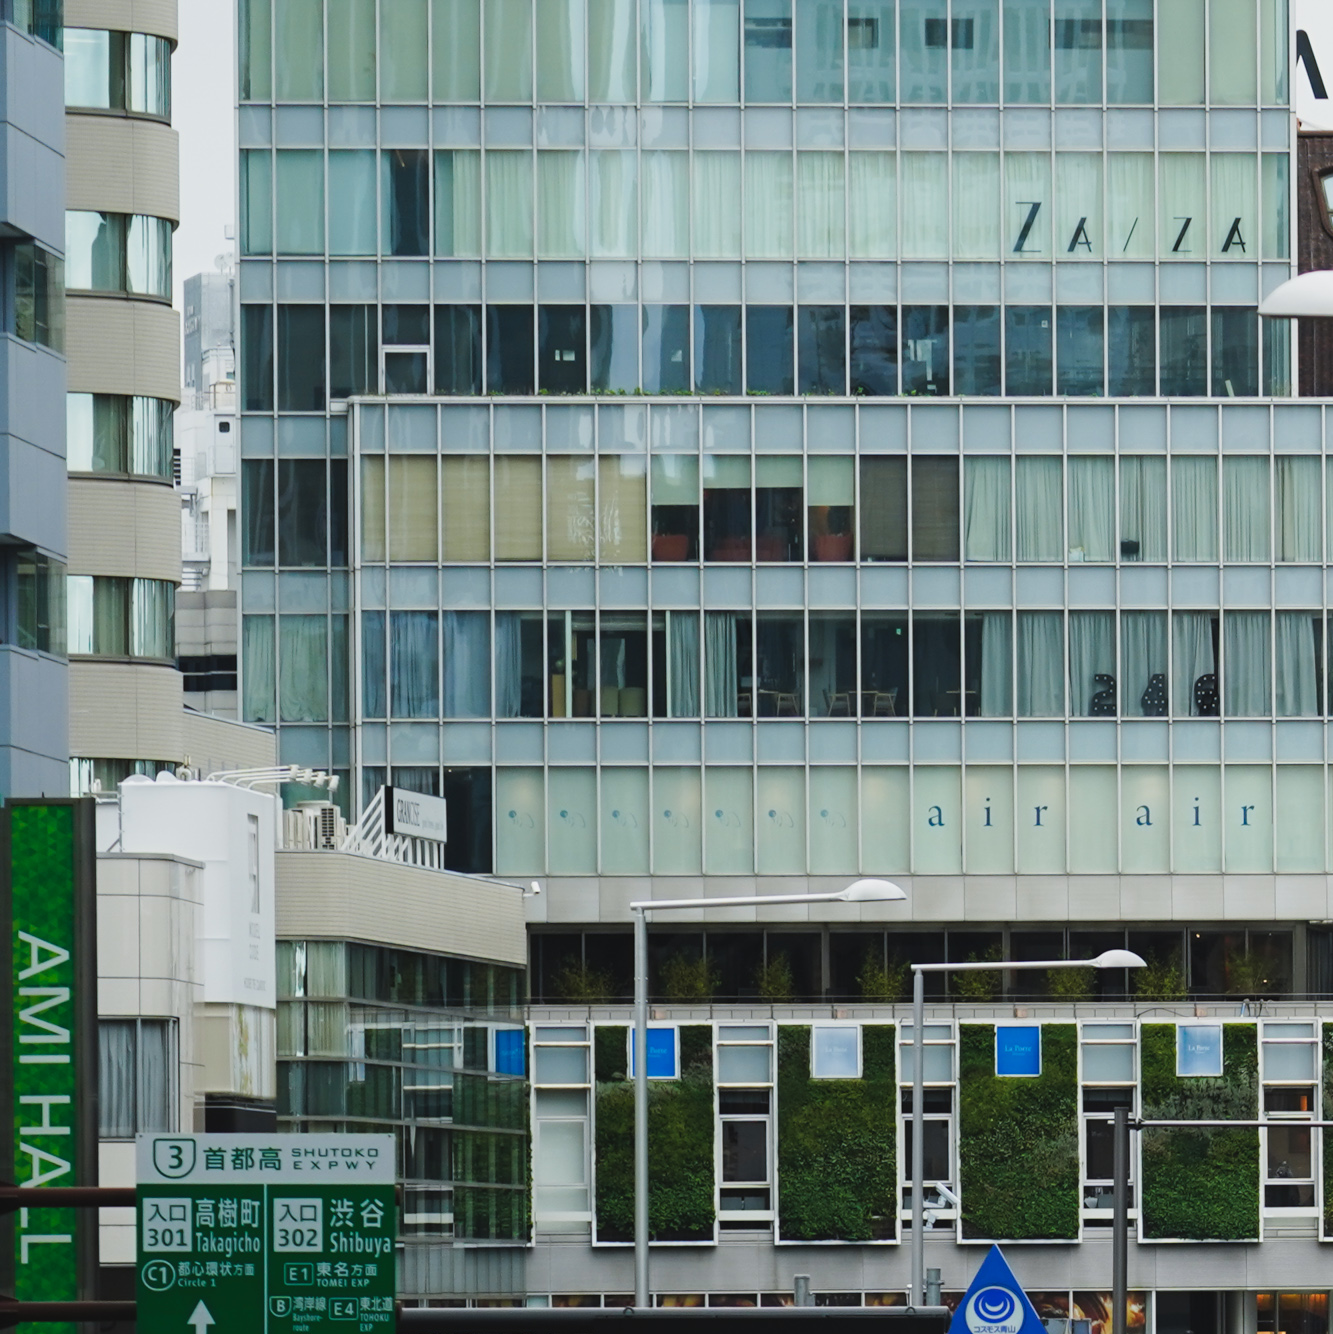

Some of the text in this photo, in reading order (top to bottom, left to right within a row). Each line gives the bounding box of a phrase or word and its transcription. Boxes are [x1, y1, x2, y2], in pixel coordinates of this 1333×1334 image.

[18, 930, 71, 1064] AMI
[168, 1145, 183, 1169] 3
[203, 1146, 282, 1171] 首都高
[291, 1148, 379, 1158] SHUTOKO
[293, 1160, 376, 1170] EXPWY
[148, 1204, 187, 1223] 入口
[195, 1198, 260, 1229] 高樹町
[278, 1204, 318, 1223] 入口
[329, 1198, 385, 1229] 渋谷
[147, 1228, 188, 1247] 301
[195, 1231, 261, 1258] Takagicho
[278, 1228, 319, 1247] 302
[329, 1231, 392, 1258] Shibuya
[148, 1266, 168, 1285] C1
[178, 1262, 255, 1277] 都心環状方面
[289, 1267, 309, 1282] E1
[316, 1262, 378, 1277] 東名方面
[178, 1278, 207, 1288] Circle
[316, 1278, 370, 1288] TOMEI EXP
[292, 1296, 326, 1312] 湾岸線
[334, 1302, 354, 1316] E4
[359, 1296, 394, 1312] 東北道
[359, 1313, 390, 1323] TOHOKU
[973, 1325, 1016, 1334] コスモス青山
